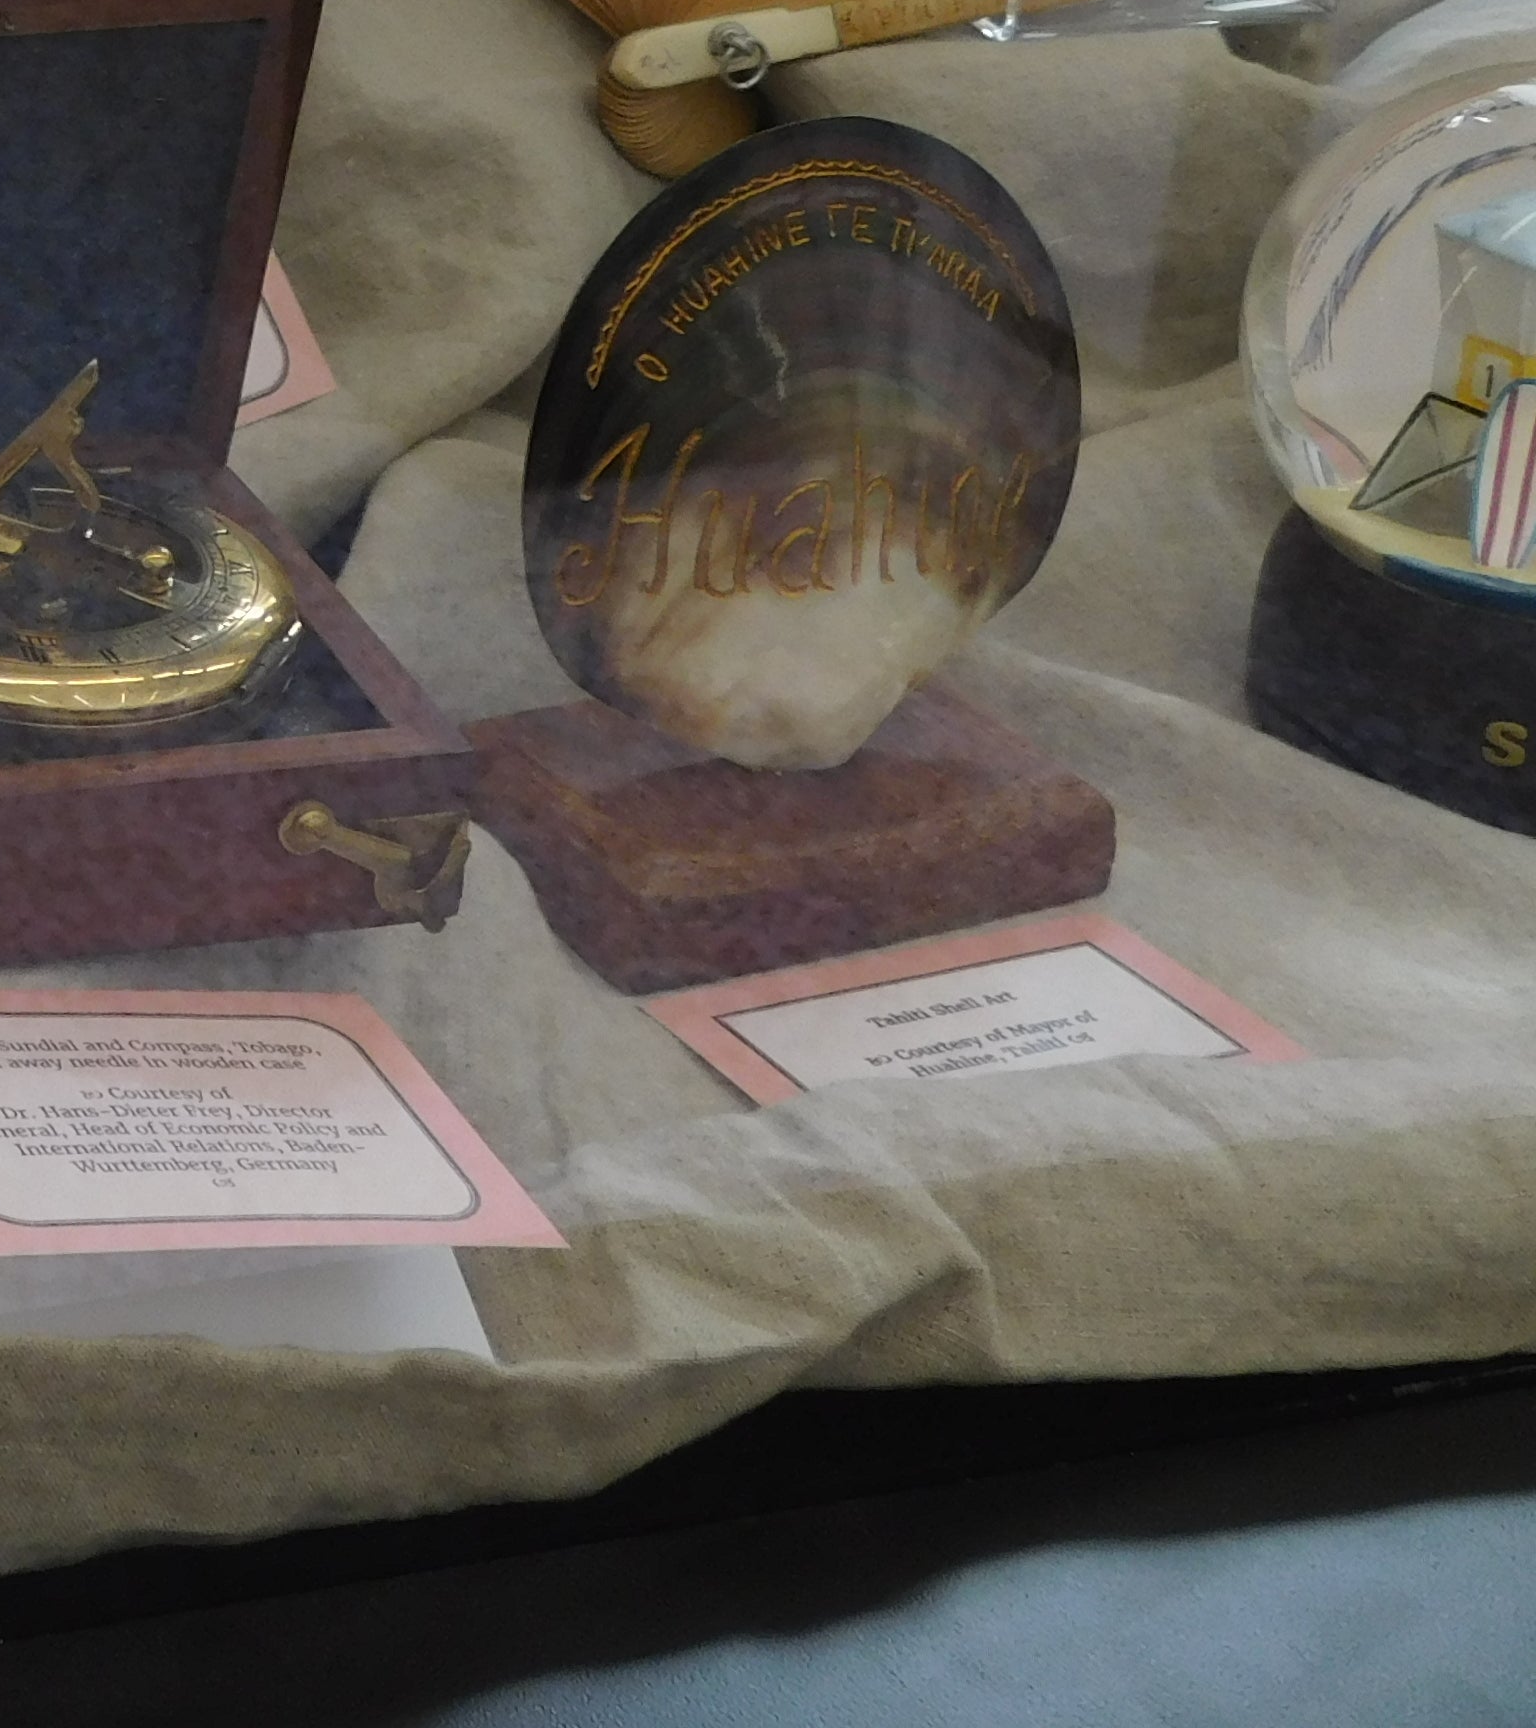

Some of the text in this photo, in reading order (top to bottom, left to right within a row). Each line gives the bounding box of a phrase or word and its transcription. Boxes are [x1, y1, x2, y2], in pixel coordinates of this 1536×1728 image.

[866, 991, 1017, 1028] Tahiti Shell Art
[894, 1009, 1098, 1060] Courtesy of Mayor of
[82, 1040, 124, 1051] and
[128, 1040, 232, 1055] Compass,
[231, 1041, 322, 1057] Tobago,
[909, 1036, 1069, 1077] Huahine, Tahiti
[8, 1057, 62, 1071] away
[68, 1055, 139, 1068] needle
[142, 1056, 168, 1068] in
[171, 1056, 255, 1069] wooden
[260, 1060, 307, 1070] case
[108, 1086, 234, 1103] Courtesy of
[0, 1104, 333, 1120] Dr. Hans-Dieter Frey, Director
[69, 1122, 130, 1136] Head
[135, 1121, 159, 1135] of
[163, 1122, 272, 1136] Economic
[274, 1122, 340, 1138] Policy
[345, 1124, 388, 1136] and
[14, 1139, 365, 1156] International Relations, Baden-
[70, 1157, 338, 1174] Wurttemberg, Germany
